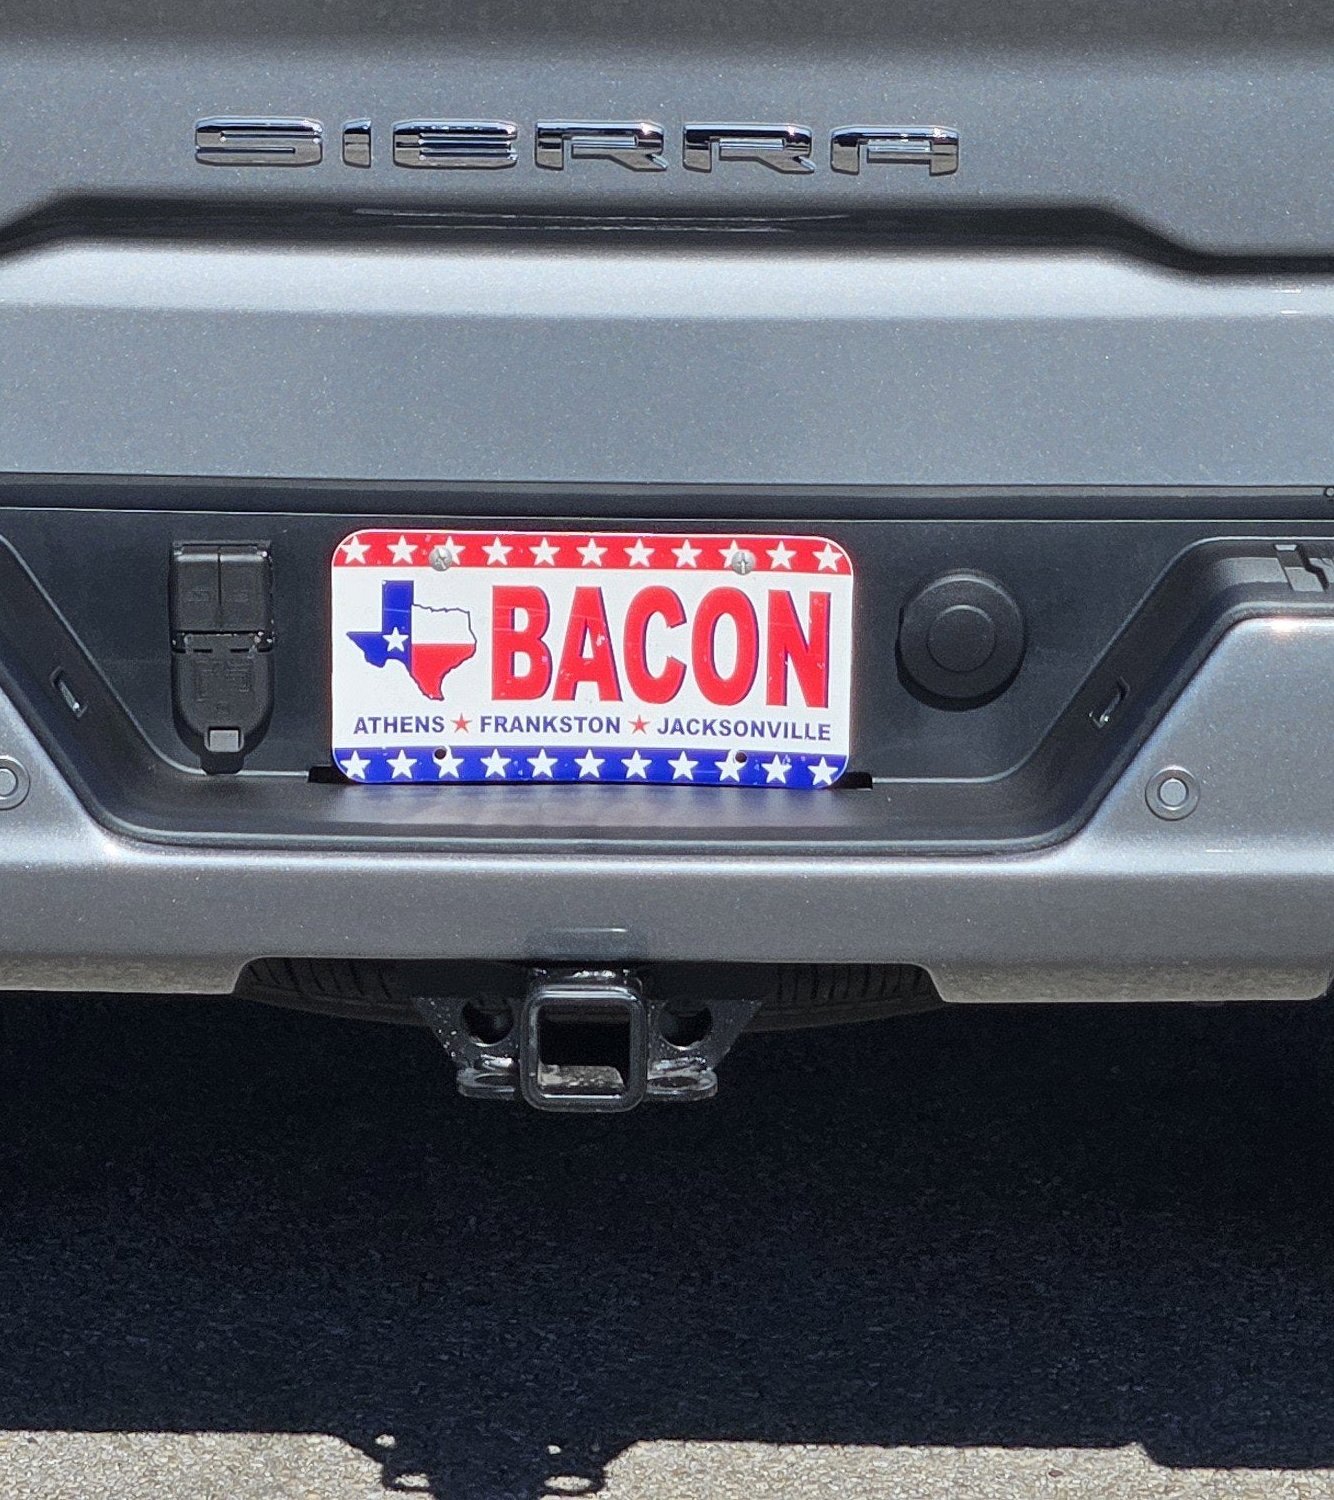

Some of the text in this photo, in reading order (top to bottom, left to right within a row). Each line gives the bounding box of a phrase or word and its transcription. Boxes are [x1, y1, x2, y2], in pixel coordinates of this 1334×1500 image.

[194, 116, 961, 175] SIERRA
[491, 584, 832, 709] BACON
[352, 714, 832, 742] ATHENS FRANKSTON JACKSONVILLE
